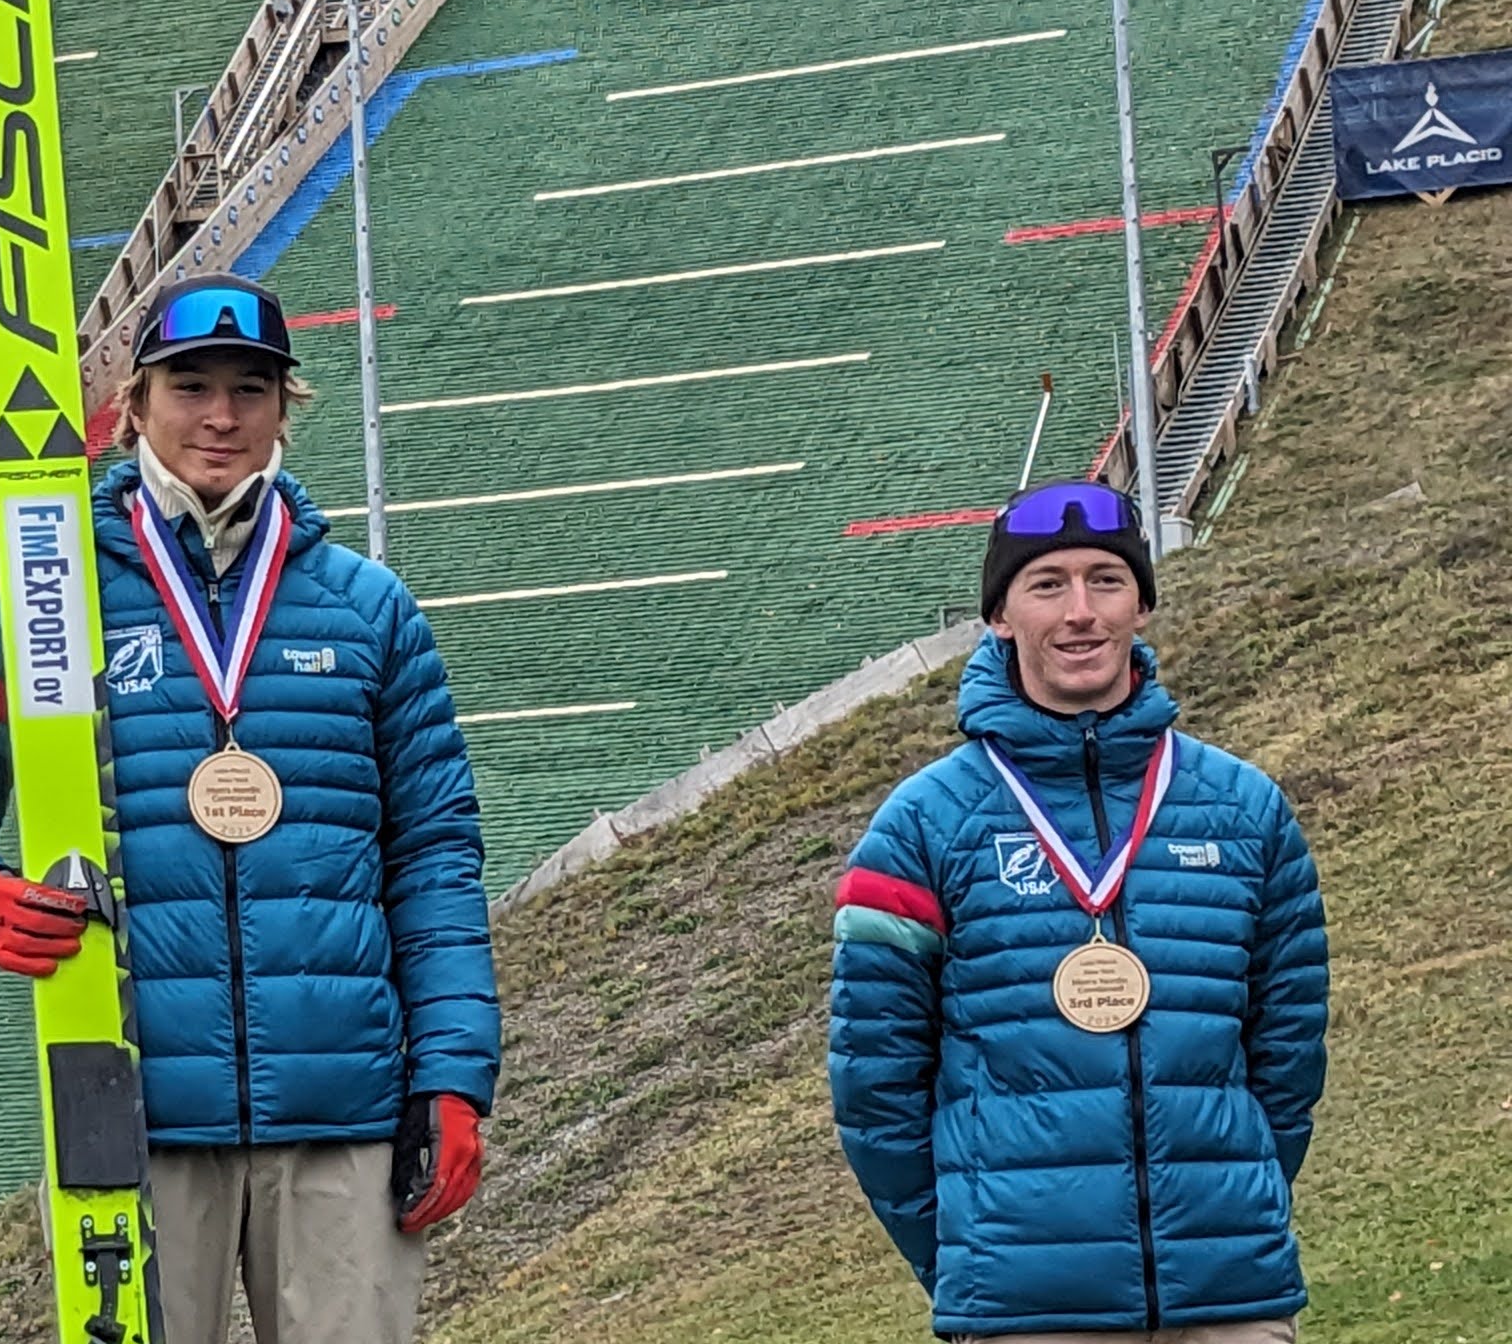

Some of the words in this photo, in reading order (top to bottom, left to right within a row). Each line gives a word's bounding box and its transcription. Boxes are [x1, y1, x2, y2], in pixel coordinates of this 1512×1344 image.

[1365, 156, 1421, 175] LAKE
[1426, 147, 1502, 168] PLACID
[117, 678, 152, 694] USA
[204, 806, 225, 817] 1st
[229, 806, 266, 817] Place
[1015, 880, 1051, 895] USA
[1069, 997, 1092, 1008] 3rd
[1097, 996, 1135, 1007] Place
